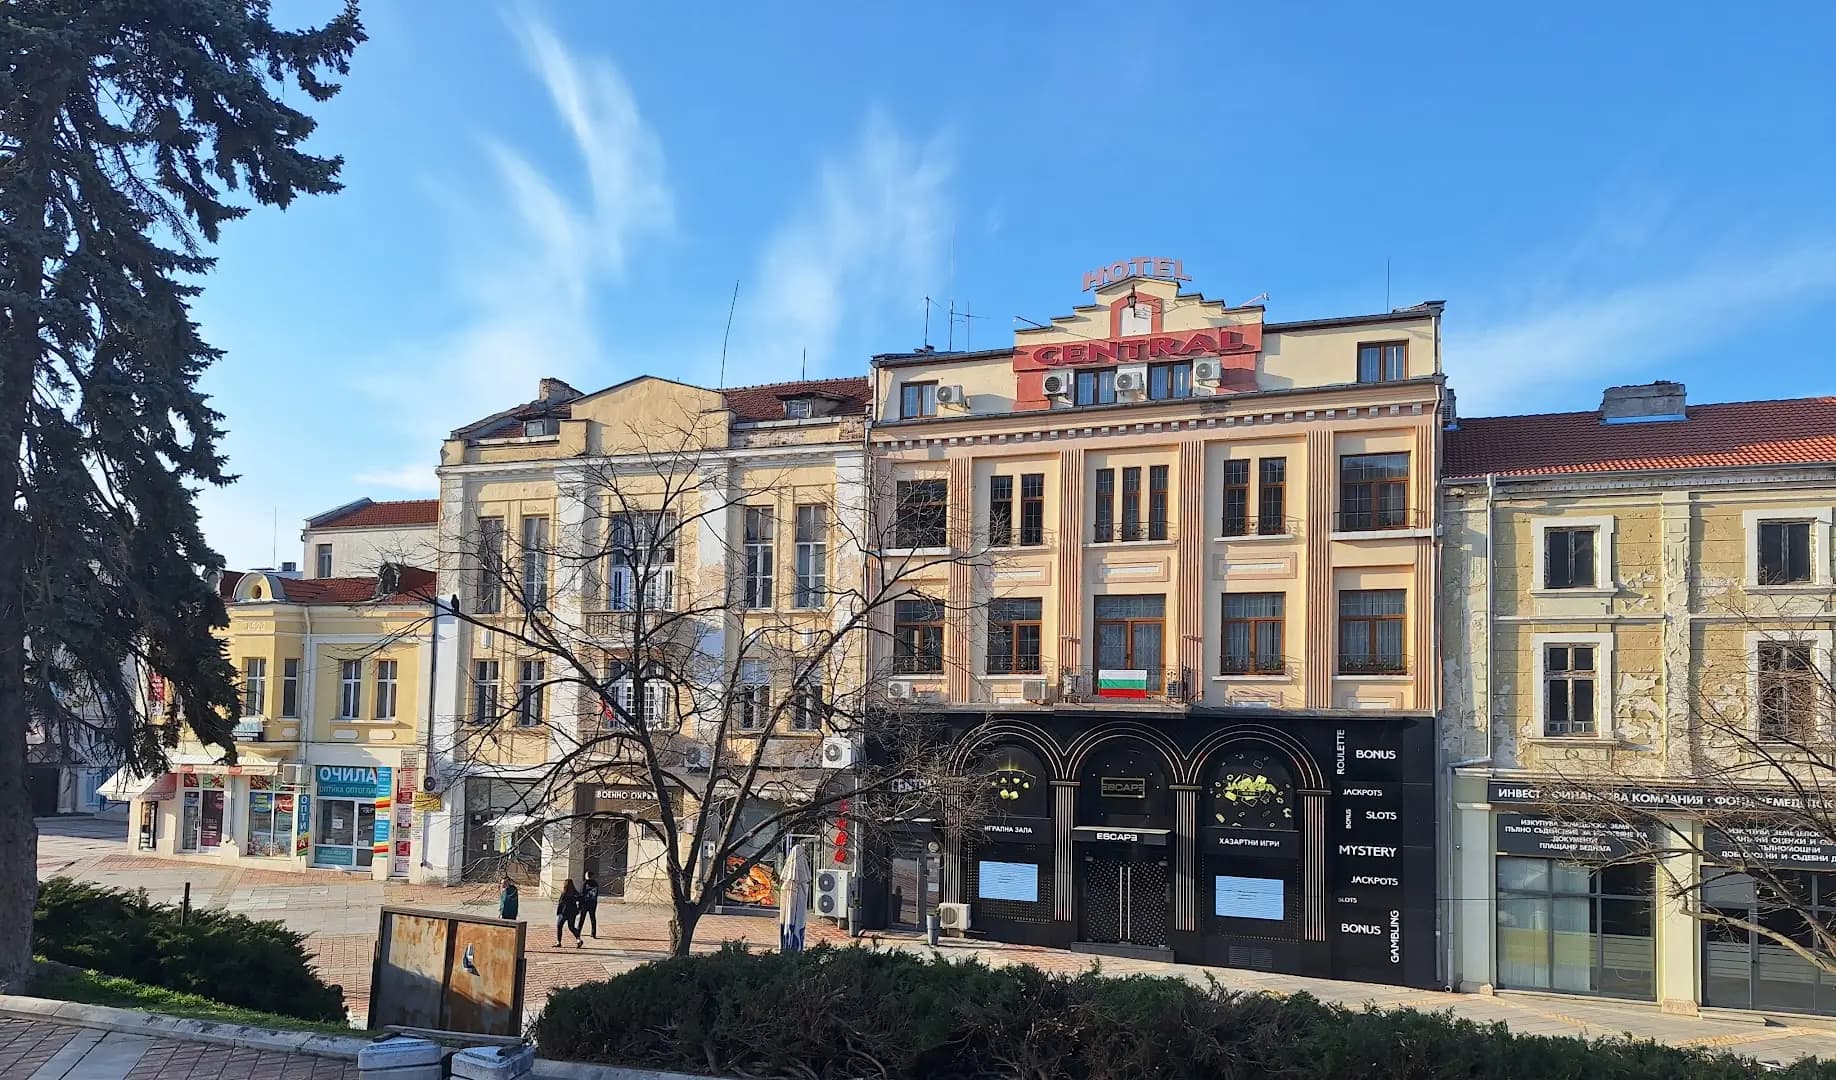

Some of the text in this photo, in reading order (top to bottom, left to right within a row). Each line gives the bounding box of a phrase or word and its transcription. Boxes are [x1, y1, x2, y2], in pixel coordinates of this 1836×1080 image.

[1082, 256, 1192, 292] HOTEL
[1033, 330, 1247, 365] CENTRAL
[1337, 729, 1345, 775] ROULETTE
[1355, 749, 1397, 760] BONUS
[320, 766, 377, 784] ОЧИЛА
[596, 790, 628, 800] ВОЕННО
[1342, 788, 1383, 797] JACKPOTS
[1498, 788, 1541, 799] ИНВЕСТ
[1632, 793, 1704, 805] КОМПАНИЯ
[1366, 811, 1397, 820] SLOTS
[1504, 826, 1532, 834] ПЪЛНО
[1096, 832, 1138, 842] ESCAPE
[1218, 838, 1280, 848] ХАЗАРТНИ ИГРИ
[1339, 845, 1396, 858] MYSTERY
[1351, 876, 1398, 886] JACKPOTS
[1341, 923, 1381, 935] BONUS
[1390, 910, 1400, 963] GAMBLING
